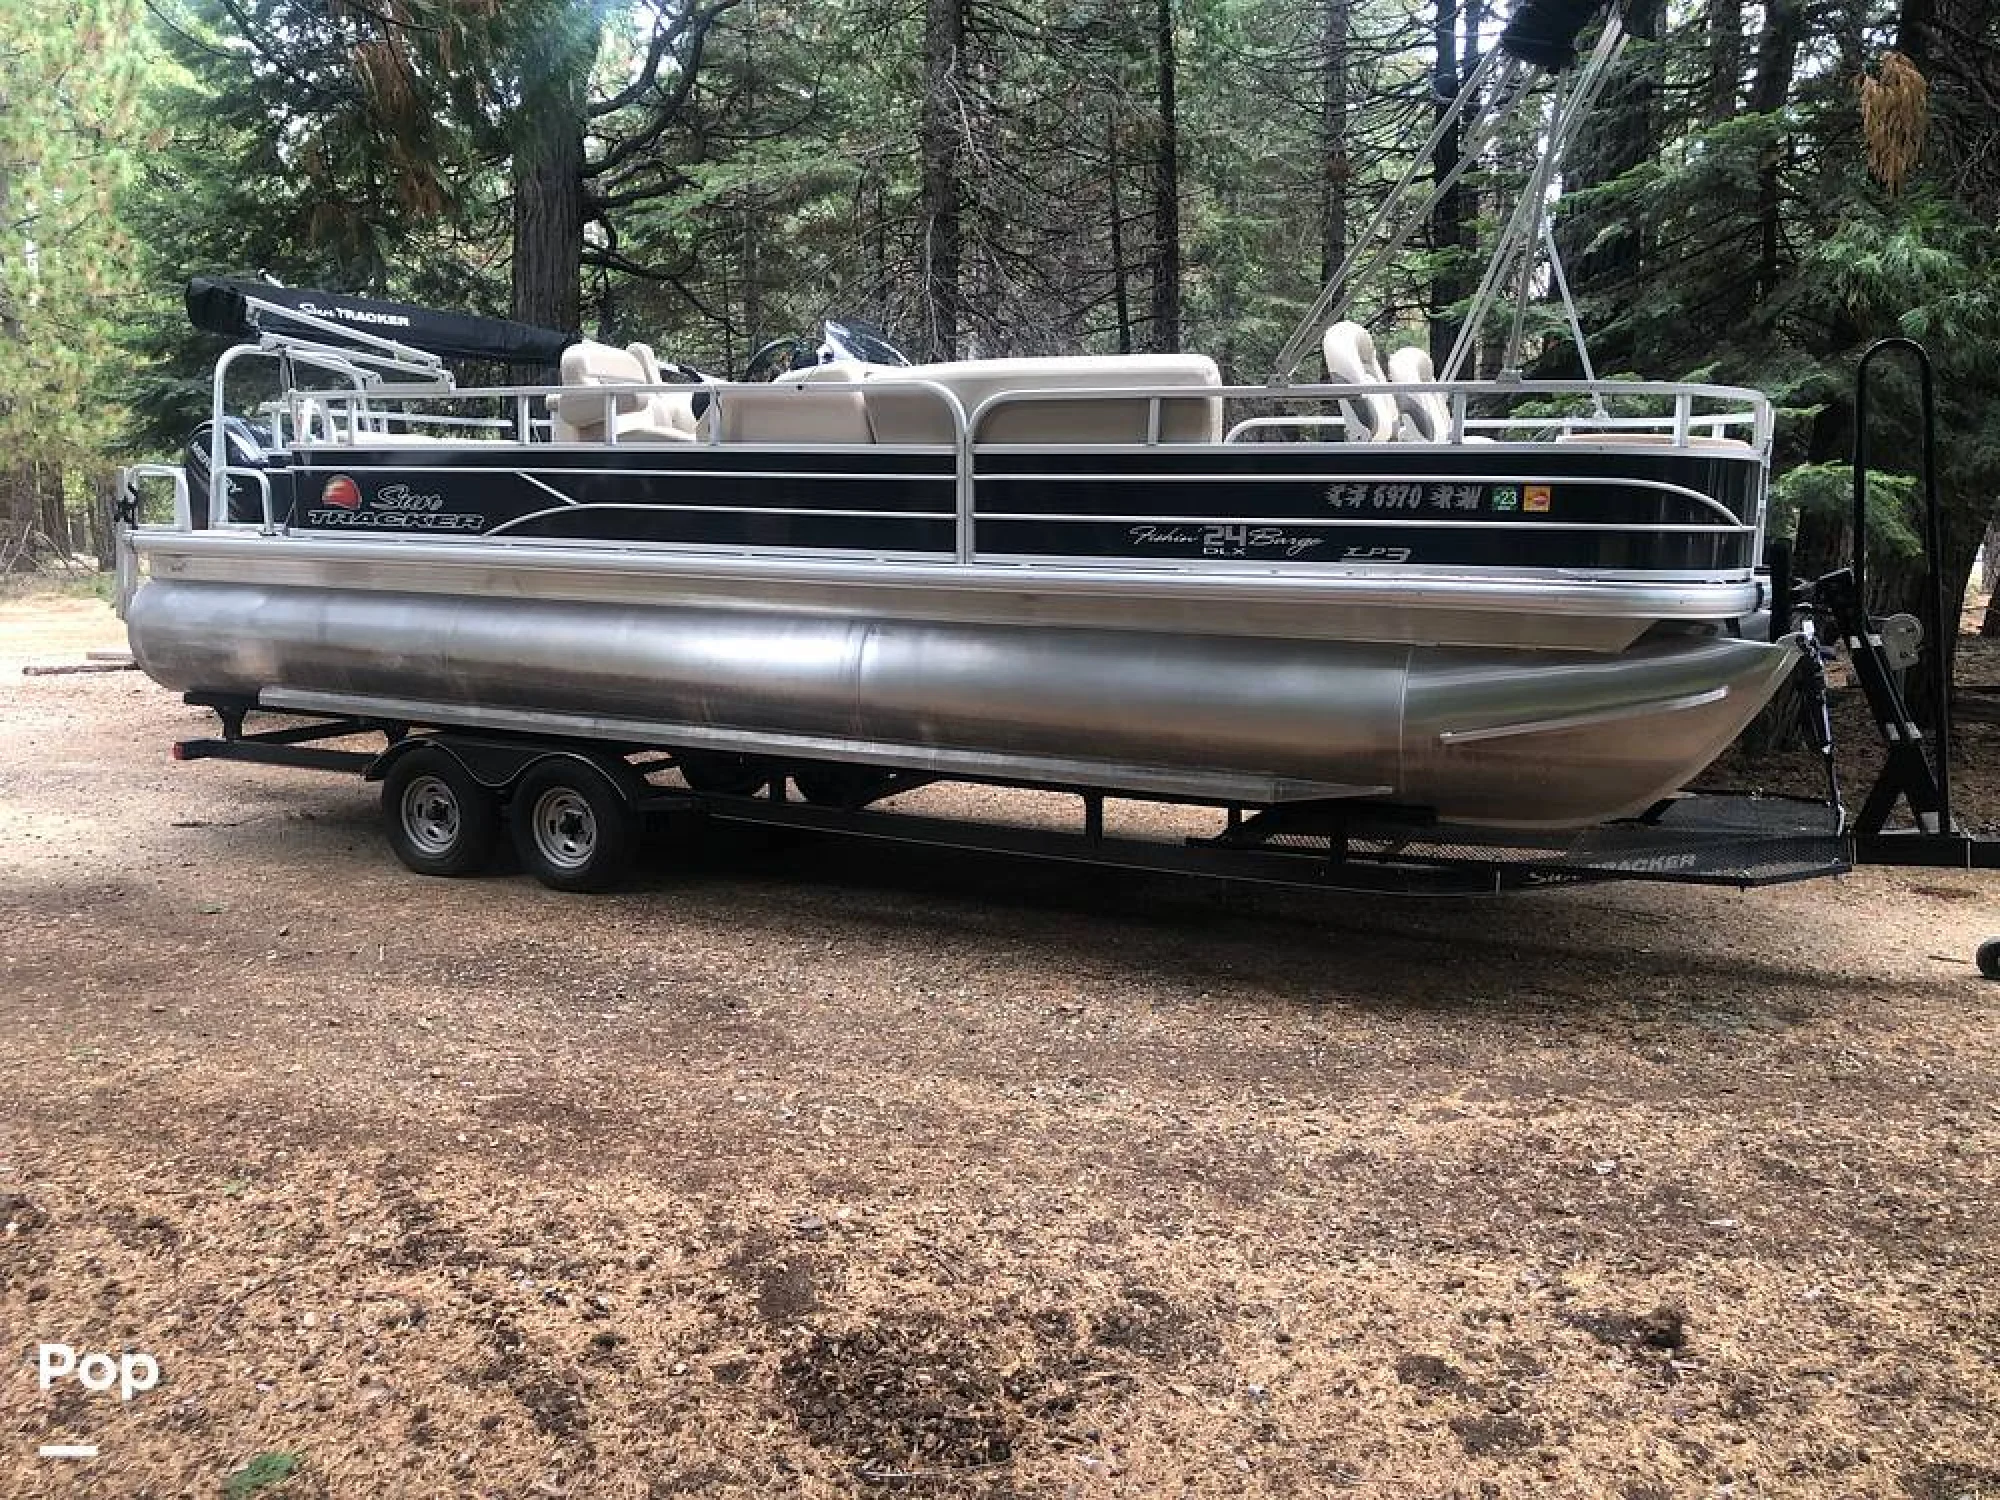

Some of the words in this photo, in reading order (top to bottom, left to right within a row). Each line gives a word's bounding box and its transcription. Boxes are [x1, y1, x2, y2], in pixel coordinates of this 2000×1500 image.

[335, 307, 411, 327] TRACKER
[370, 483, 443, 511] Sun
[1373, 484, 1423, 509] 6970
[307, 509, 485, 529] TRACKER
[1203, 524, 1247, 547] 24
[1249, 527, 1326, 557] Barge
[1203, 547, 1246, 556] DLX
